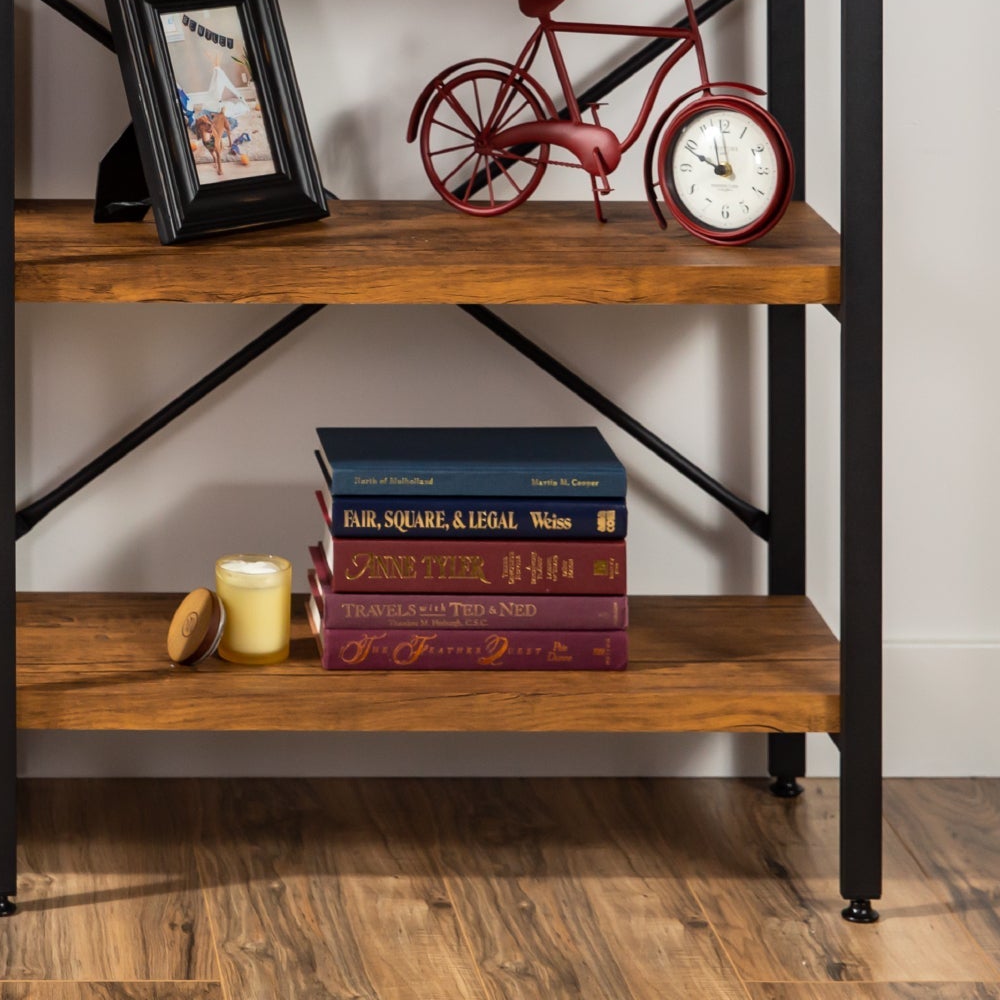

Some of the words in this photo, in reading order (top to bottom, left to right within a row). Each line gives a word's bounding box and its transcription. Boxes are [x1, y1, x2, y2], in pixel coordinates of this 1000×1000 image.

[739, 126, 748, 139] 1
[751, 143, 765, 157] 2
[757, 166, 769, 176] 3
[721, 205, 730, 219] 6
[354, 476, 377, 485] North
[379, 476, 388, 485] of
[389, 476, 434, 485] Mulholland
[531, 478, 558, 486] Martin
[571, 479, 599, 488] Cooper
[343, 509, 381, 530] FAIR,
[384, 510, 449, 532] SQUARE,
[452, 511, 466, 529] &
[468, 511, 518, 530] LEGAL
[530, 511, 572, 530] Weiss
[345, 553, 416, 580] ANNE
[421, 555, 491, 584] TYLER
[341, 603, 417, 617] TRAVELS
[420, 603, 447, 614] with
[449, 602, 486, 617] TED
[488, 606, 497, 616] &
[499, 602, 537, 617] NED
